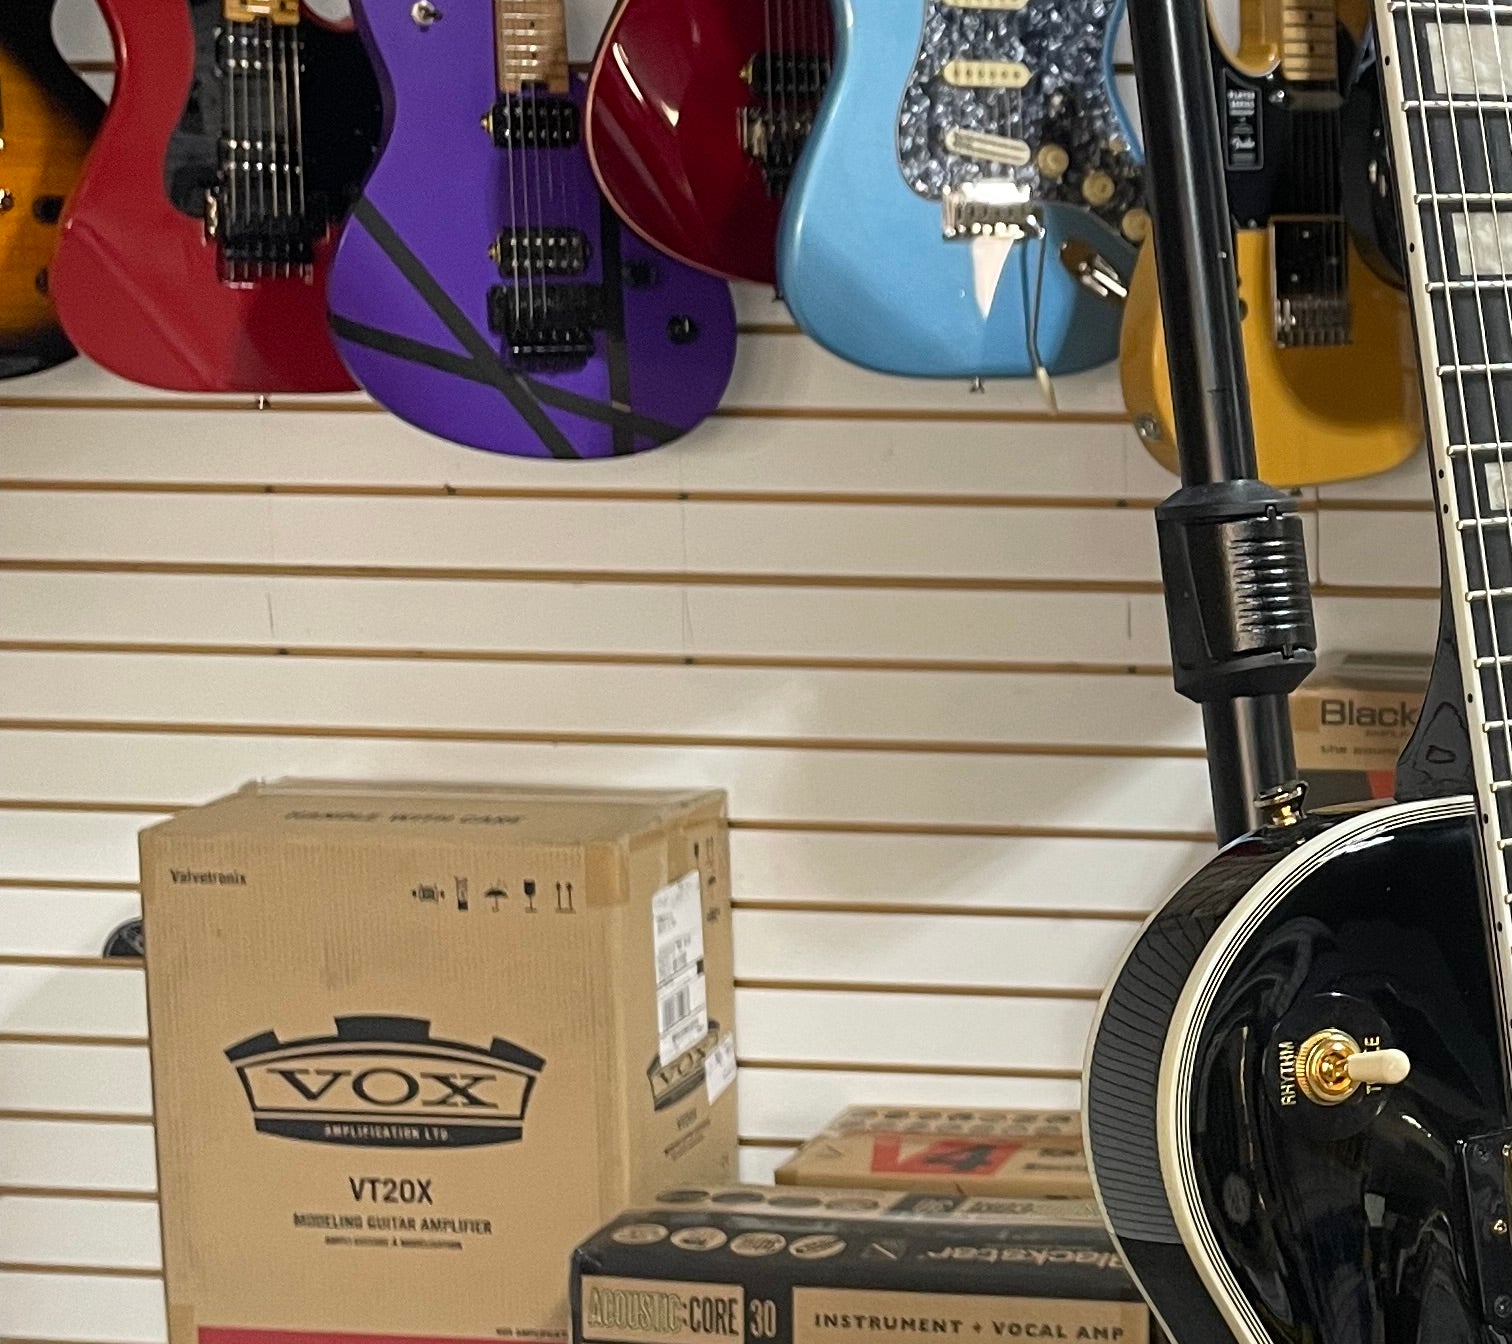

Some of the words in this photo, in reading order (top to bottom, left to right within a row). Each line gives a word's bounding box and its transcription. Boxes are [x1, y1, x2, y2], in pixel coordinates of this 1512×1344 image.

[1320, 698, 1419, 728] Black
[266, 1067, 499, 1109] VOX
[1278, 1040, 1297, 1106] RHYTHM
[349, 1176, 434, 1205] VT20X
[750, 1298, 778, 1339] 30
[814, 1312, 964, 1335] INSTRUMENT
[991, 1320, 1068, 1340] VOCAL
[1075, 1324, 1125, 1342] AMP
